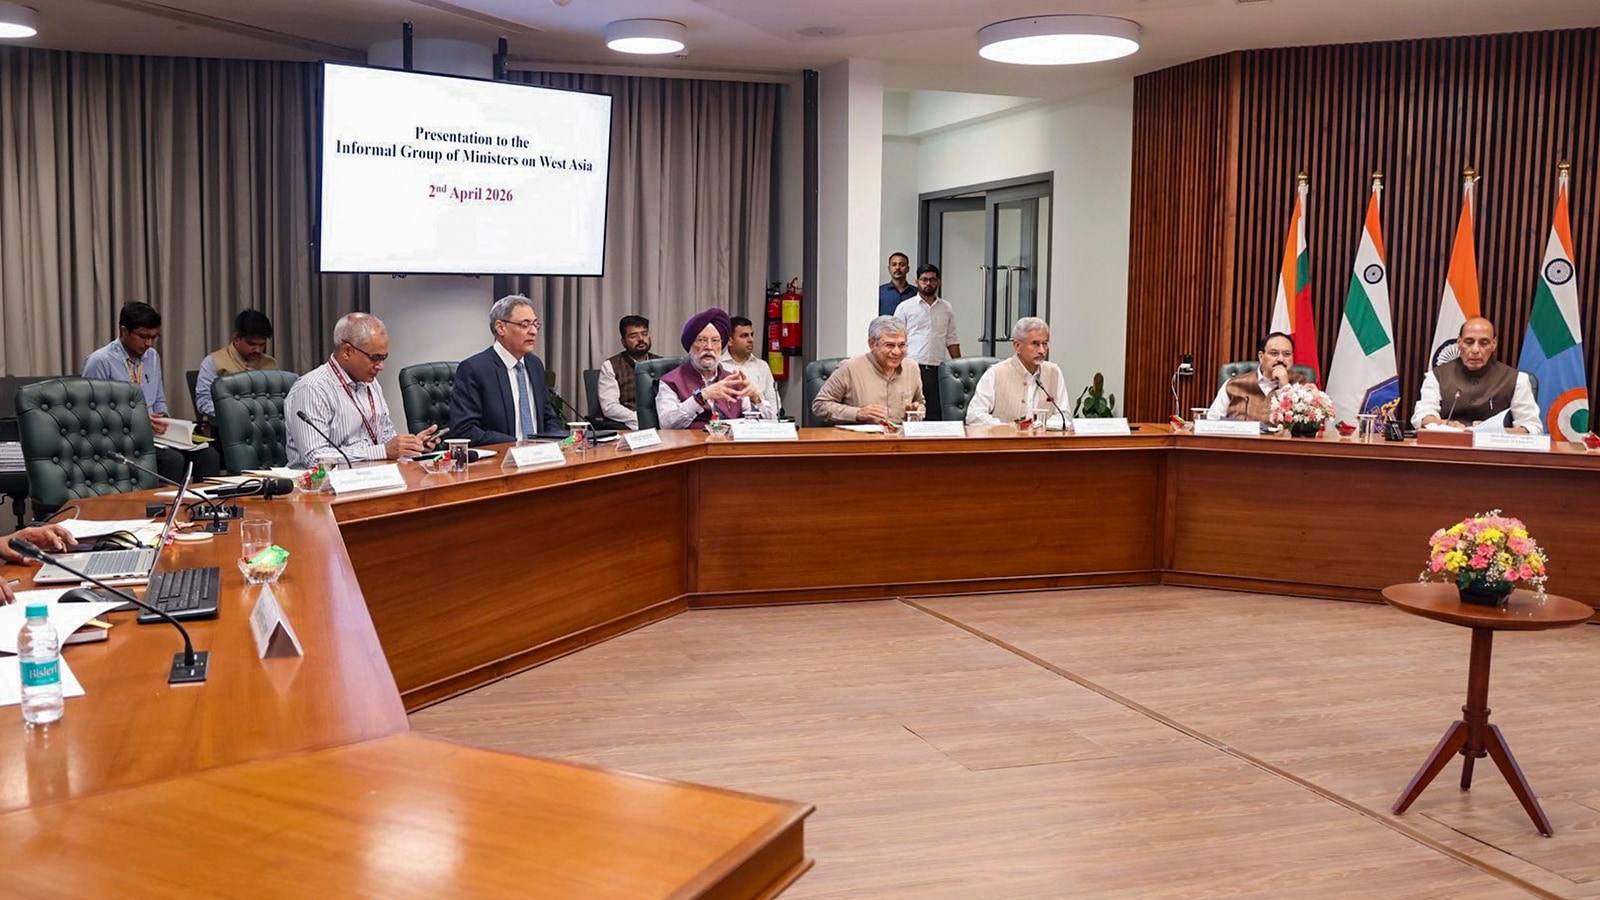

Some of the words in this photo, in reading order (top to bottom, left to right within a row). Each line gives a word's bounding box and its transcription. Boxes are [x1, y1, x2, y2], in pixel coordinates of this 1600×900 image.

[415, 126, 493, 146] Presentation
[496, 135, 509, 148] to
[511, 135, 530, 149] the
[336, 139, 397, 158] Informal
[400, 144, 443, 164] Group
[446, 149, 461, 163] of
[462, 149, 519, 167] Ministers
[521, 157, 536, 168] on
[539, 155, 567, 171] West
[569, 158, 593, 173] Asia
[428, 184, 448, 199] 2nd
[450, 186, 483, 203] April
[485, 188, 514, 202] 2026
